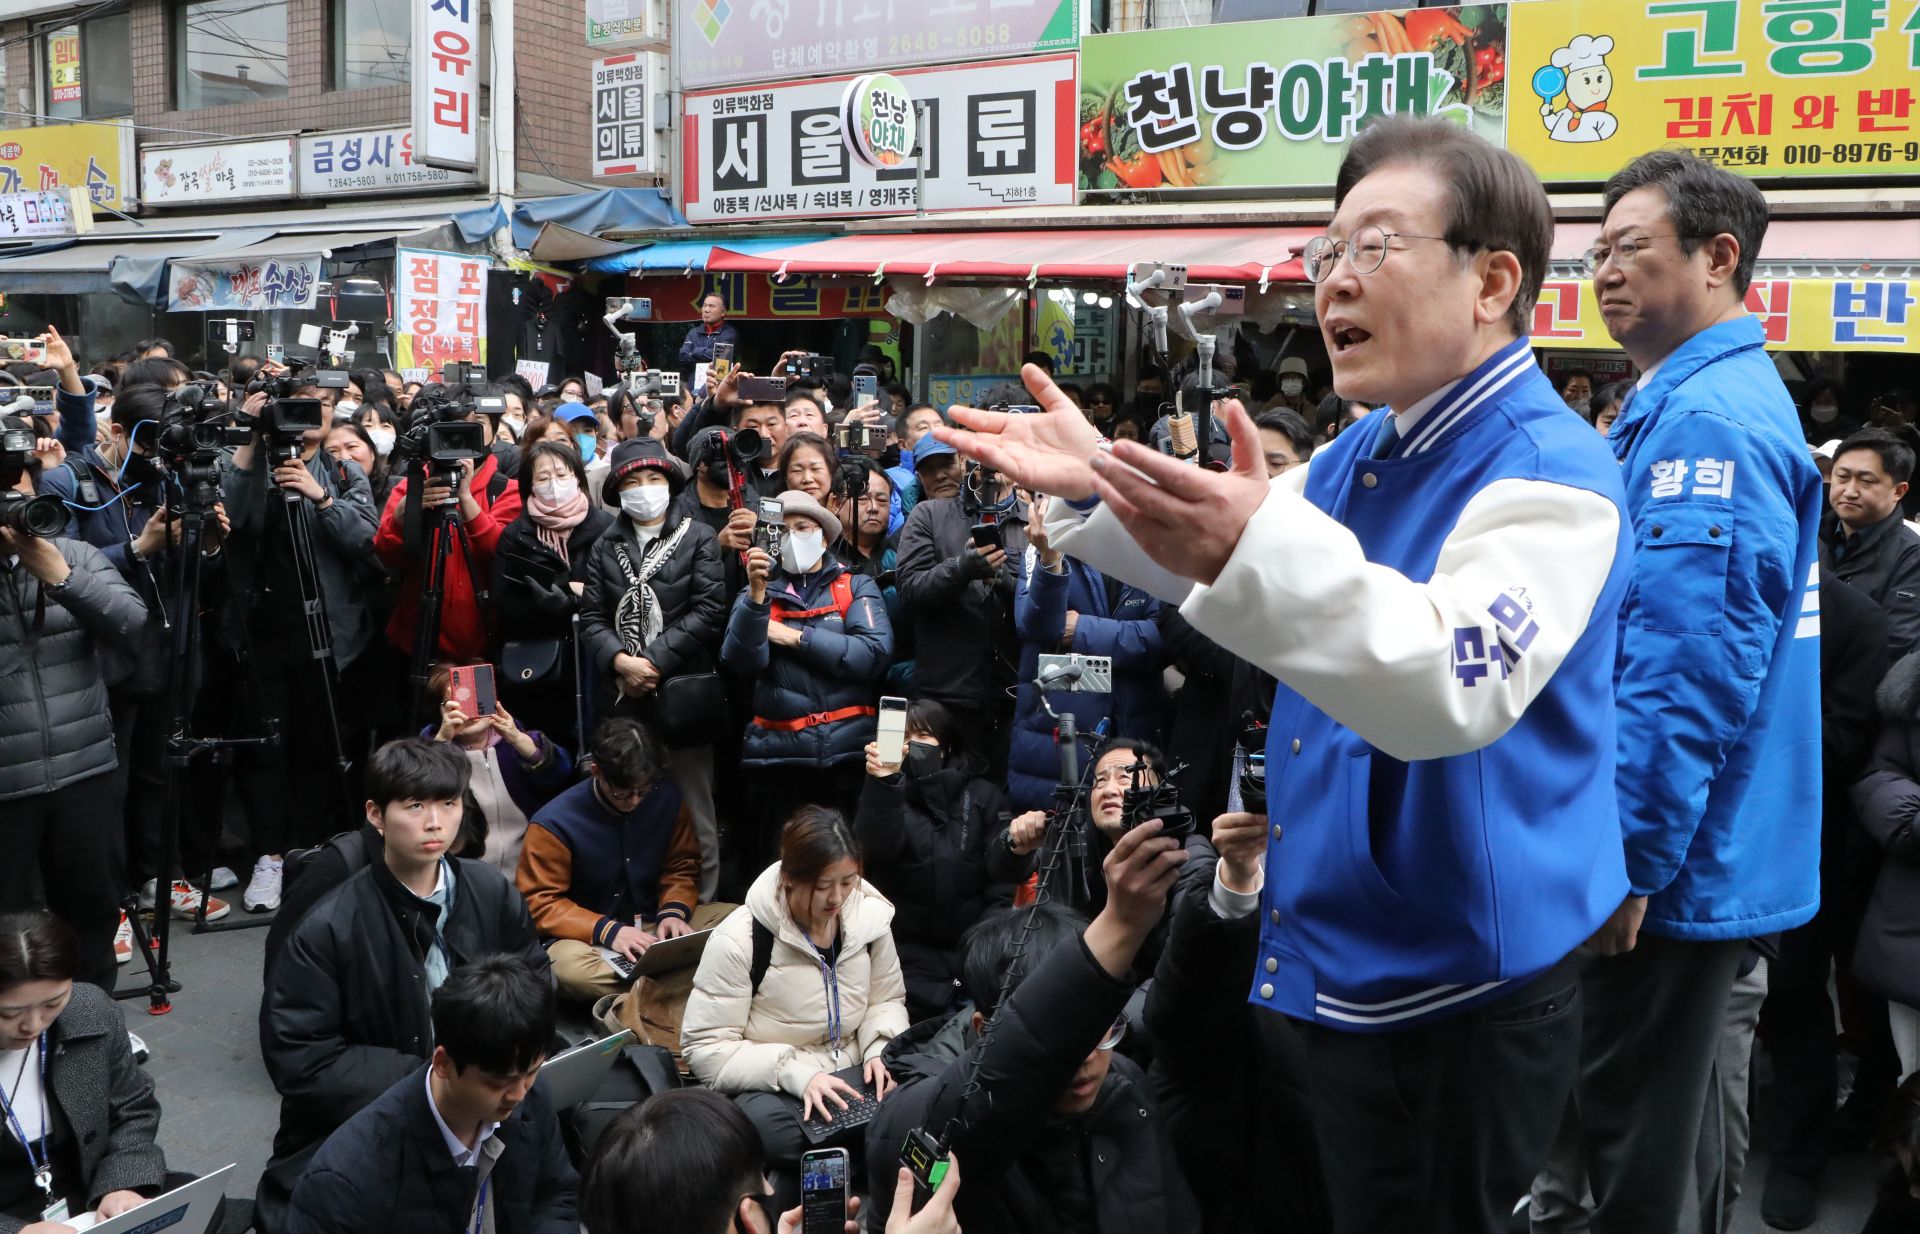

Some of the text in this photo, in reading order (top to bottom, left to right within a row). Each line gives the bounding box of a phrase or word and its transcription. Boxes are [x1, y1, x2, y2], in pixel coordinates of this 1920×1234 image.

[772, 37, 878, 69] 단체예약환영
[889, 24, 1010, 54] 2648-5058
[1637, 0, 1920, 79] 고향
[597, 65, 643, 86] 의류백화점
[599, 87, 641, 120] 서울
[713, 93, 775, 116] 의류백화점
[872, 90, 907, 125] 천냥
[1664, 88, 1917, 139] 김치 와 반
[600, 125, 641, 157] 의류
[717, 99, 1026, 182] 서울류
[872, 119, 905, 153] 야채
[1677, 142, 1920, 167] 문전화 010-8976-9
[713, 196, 750, 214] 아동복
[813, 190, 853, 208] 숙녀복
[1005, 186, 1037, 199] 지하1층
[263, 261, 313, 308] 수산
[410, 258, 481, 295] 점포
[409, 299, 480, 337] 정리
[1833, 281, 1915, 344] 반
[421, 336, 473, 354] 신사복
[1650, 458, 1735, 499] 황희
